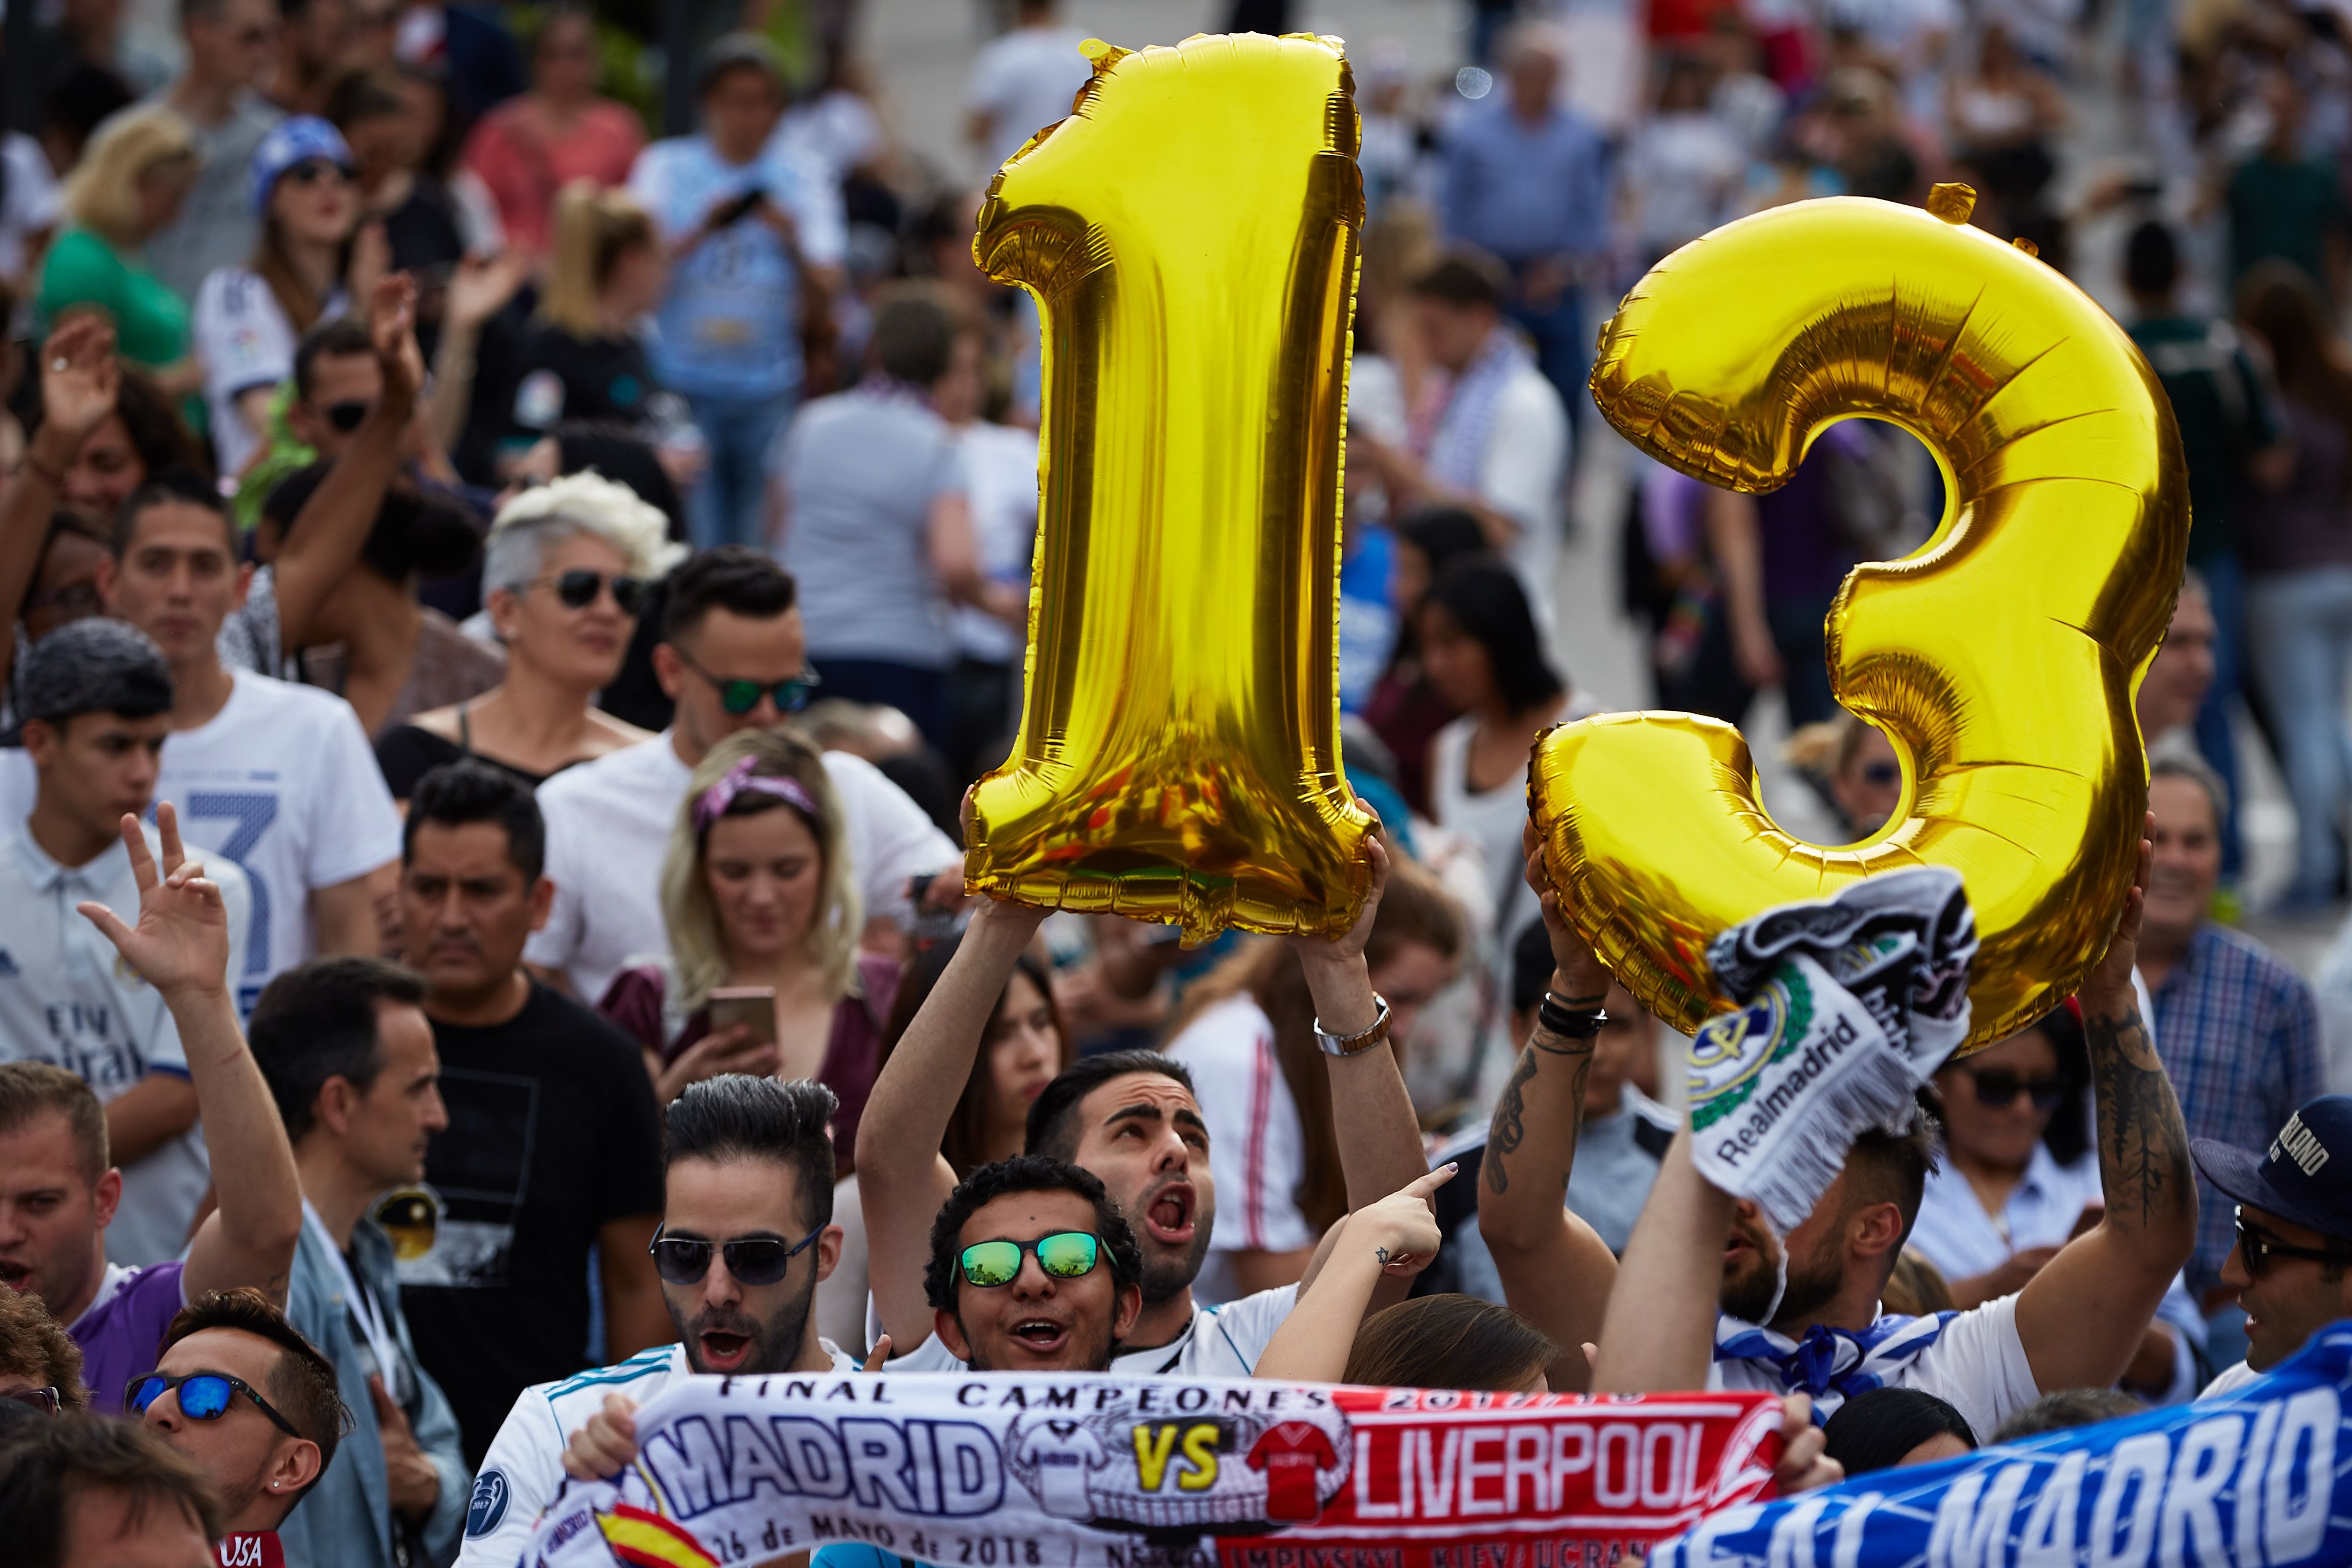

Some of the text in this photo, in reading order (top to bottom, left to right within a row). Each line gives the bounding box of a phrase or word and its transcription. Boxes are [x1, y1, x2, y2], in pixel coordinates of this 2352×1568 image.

[1716, 1012, 1859, 1168] Realmadrid
[719, 1379, 893, 1403] FINAL
[957, 1383, 1325, 1410] CAMPEONES
[642, 1415, 1007, 1521] MADRID
[1132, 1423, 1221, 1492] VS
[1355, 1423, 1708, 1519] LIVERPOOL
[1927, 1385, 2341, 1568] MADRID
[218, 1536, 262, 1567] USA
[713, 1530, 746, 1564] 26
[810, 1514, 895, 1549] MAYO
[957, 1536, 1041, 1566] 2018
